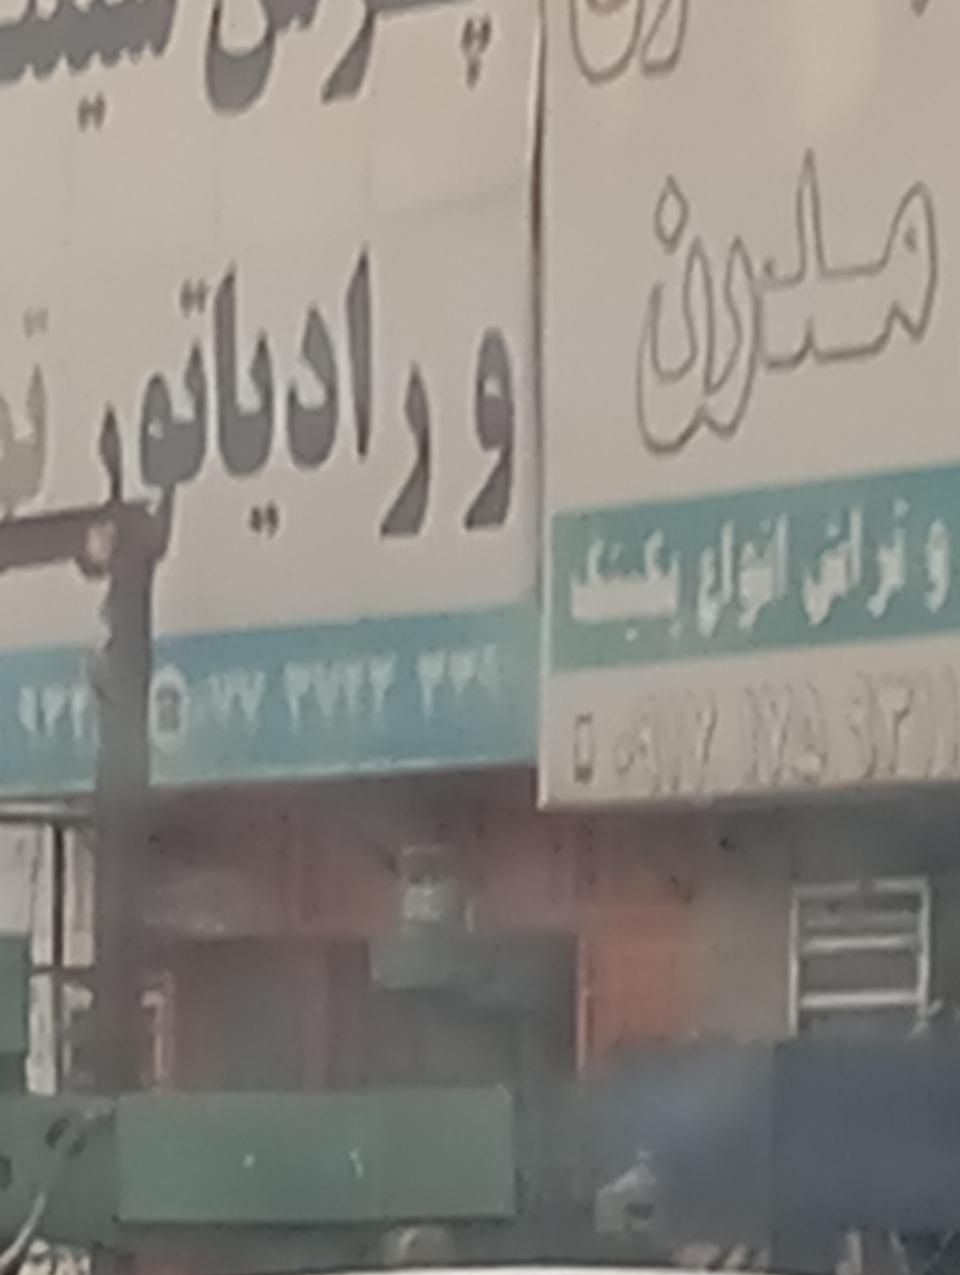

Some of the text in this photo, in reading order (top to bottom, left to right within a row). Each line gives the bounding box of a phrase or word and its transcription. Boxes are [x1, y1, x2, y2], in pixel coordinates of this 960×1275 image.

[98, 246, 432, 562] رادیاتور
[463, 328, 514, 531] و
[636, 148, 938, 456] مدرن
